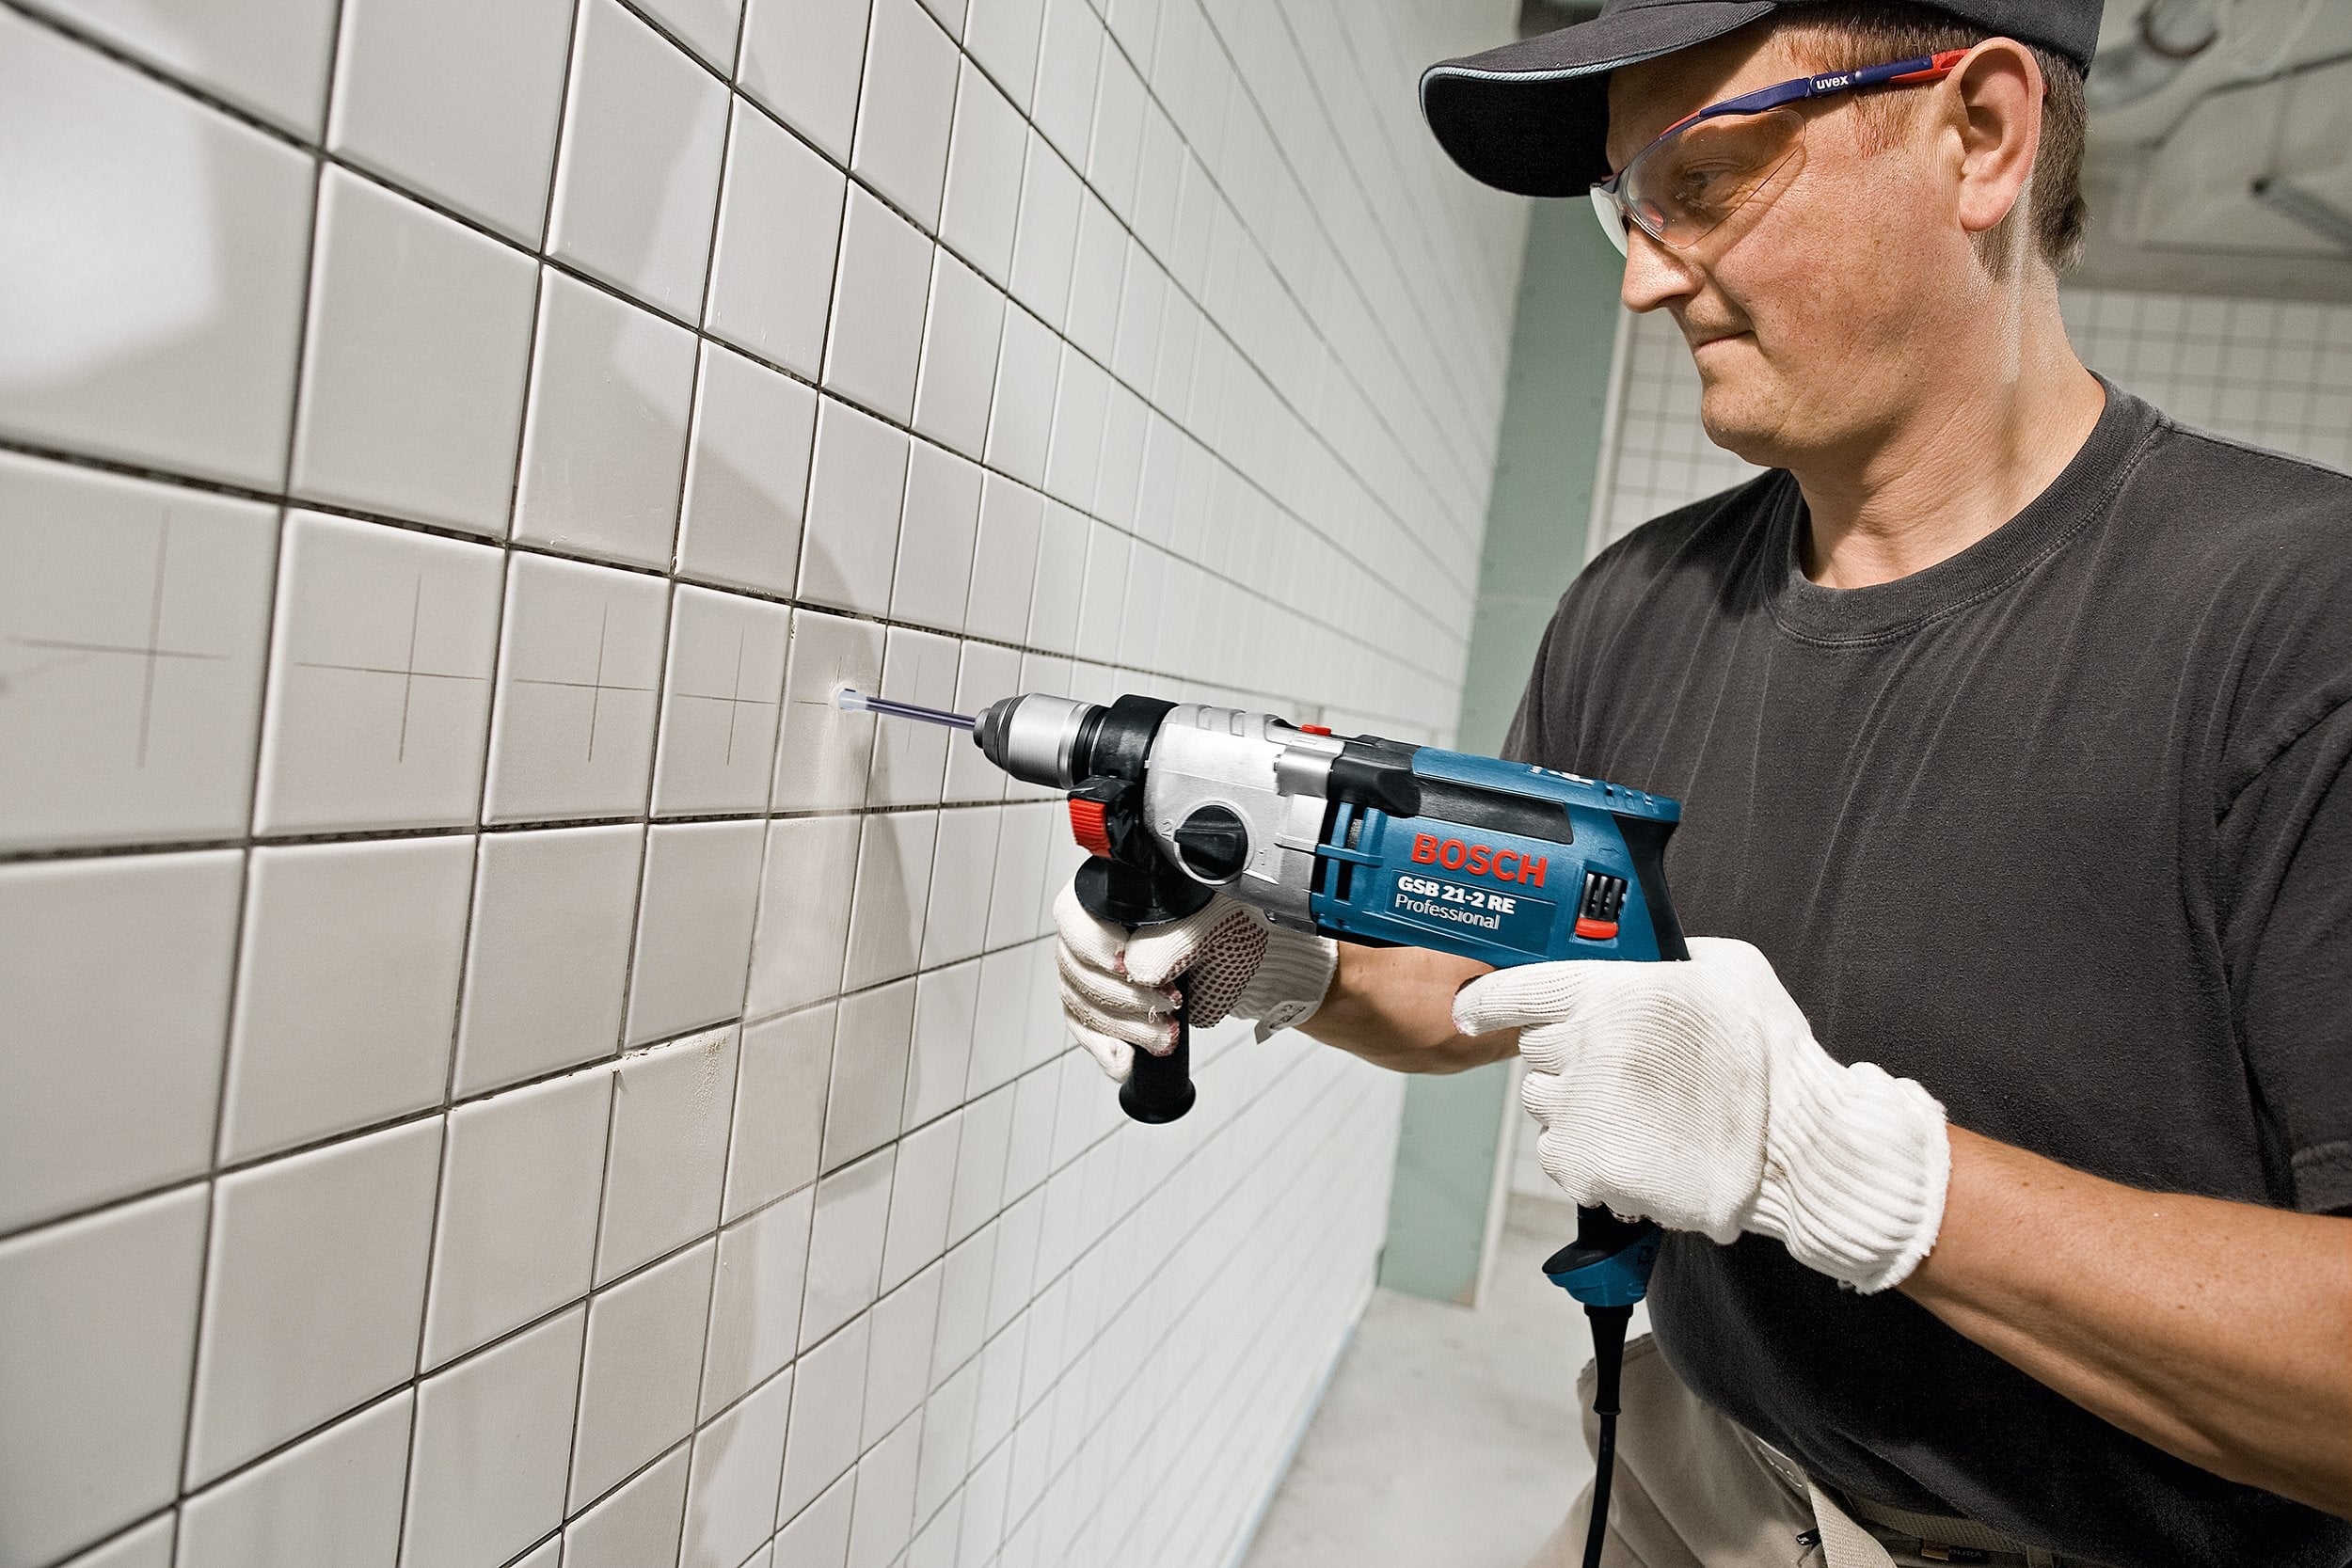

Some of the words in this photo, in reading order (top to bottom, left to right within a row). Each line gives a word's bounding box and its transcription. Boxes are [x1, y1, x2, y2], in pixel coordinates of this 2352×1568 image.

[1816, 75, 1850, 90] uvex
[1411, 832, 1548, 888] BOSCH
[1394, 893, 1501, 930] Professional
[1397, 876, 1439, 897] GSB
[1440, 885, 1486, 909] 21-2
[1486, 895, 1517, 915] RE
